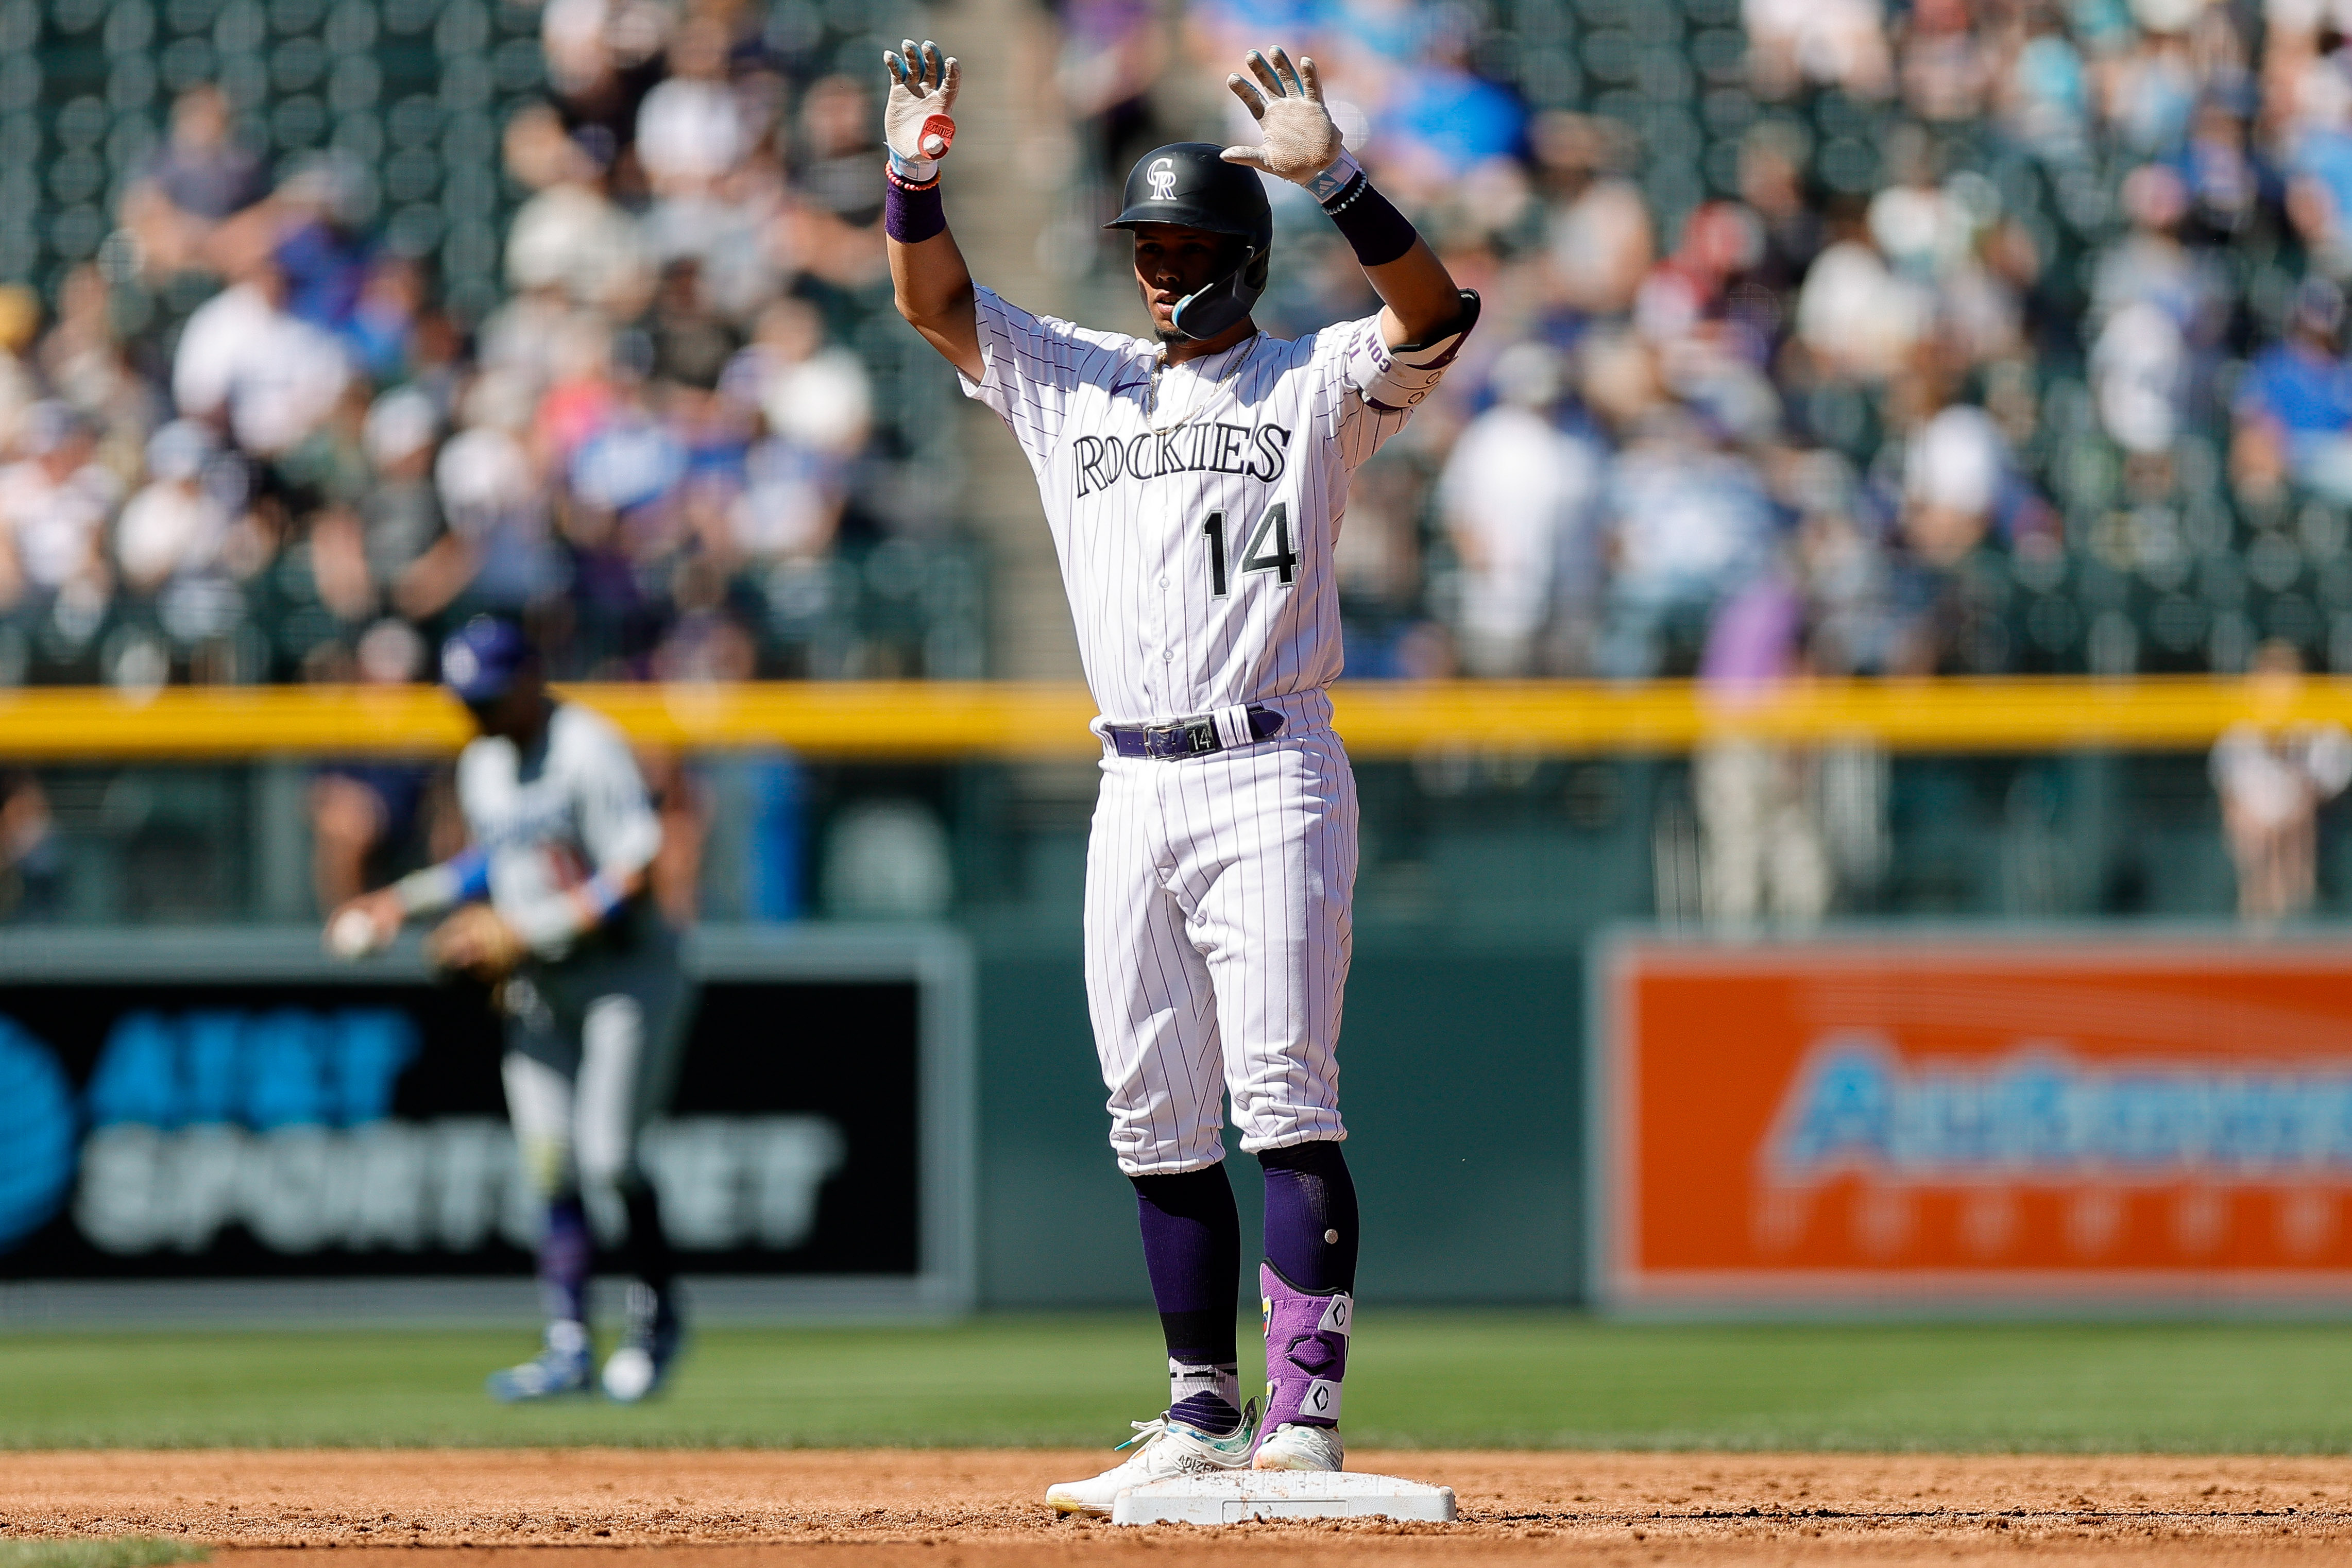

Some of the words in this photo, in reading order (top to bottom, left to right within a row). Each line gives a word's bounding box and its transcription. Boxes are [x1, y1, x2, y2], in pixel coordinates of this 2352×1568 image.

[1365, 331, 1392, 373] CON
[1073, 421, 1291, 499] ROCKIES
[1202, 499, 1301, 600] 14
[1189, 728, 1211, 750] 14
